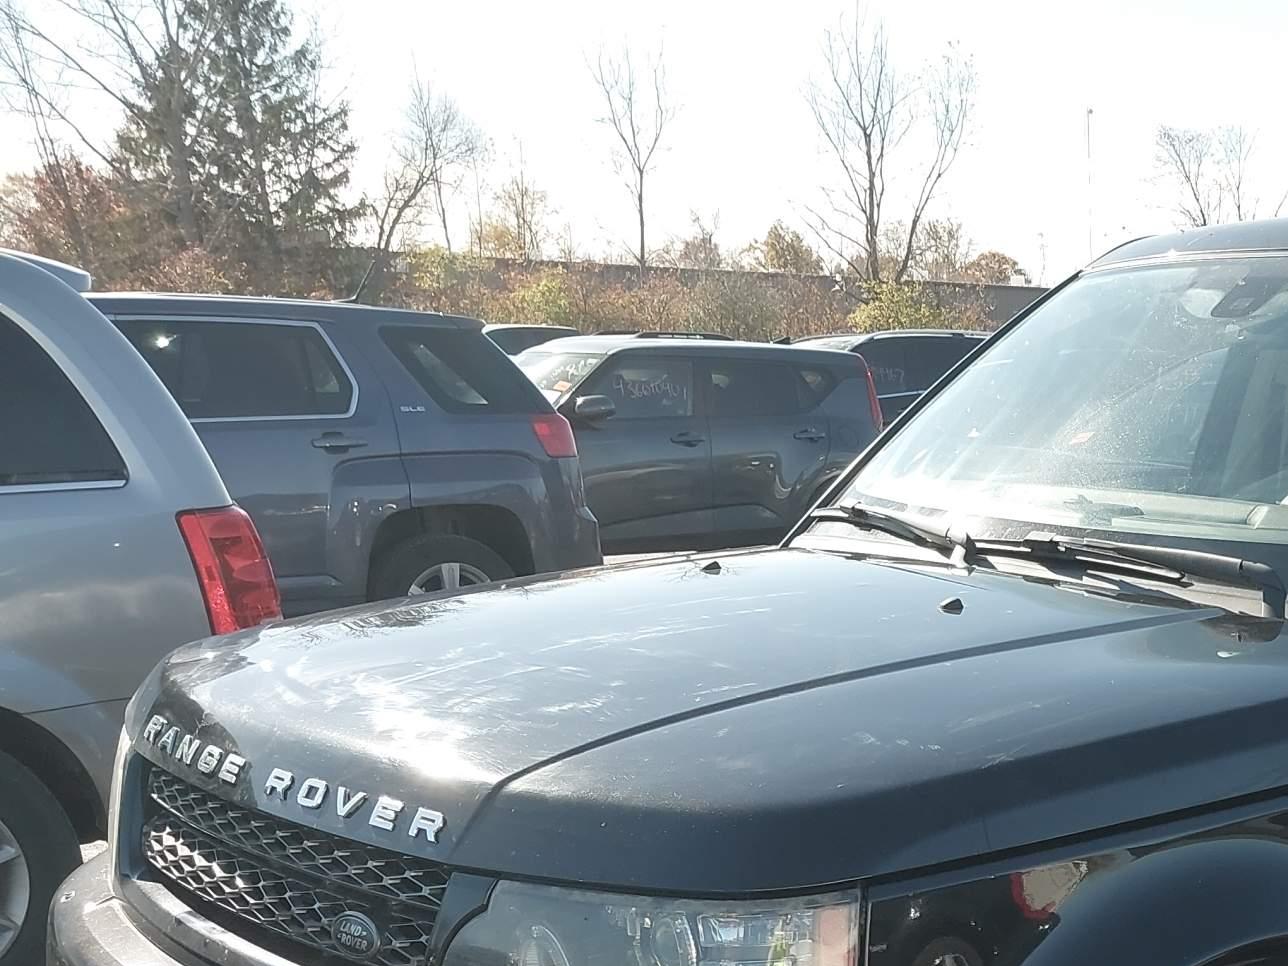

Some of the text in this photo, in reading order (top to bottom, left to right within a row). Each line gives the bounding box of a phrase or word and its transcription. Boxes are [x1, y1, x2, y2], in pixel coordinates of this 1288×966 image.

[143, 714, 446, 844] RANGE ROVER
[340, 920, 362, 936] LAND
[340, 932, 368, 951] ROVER
